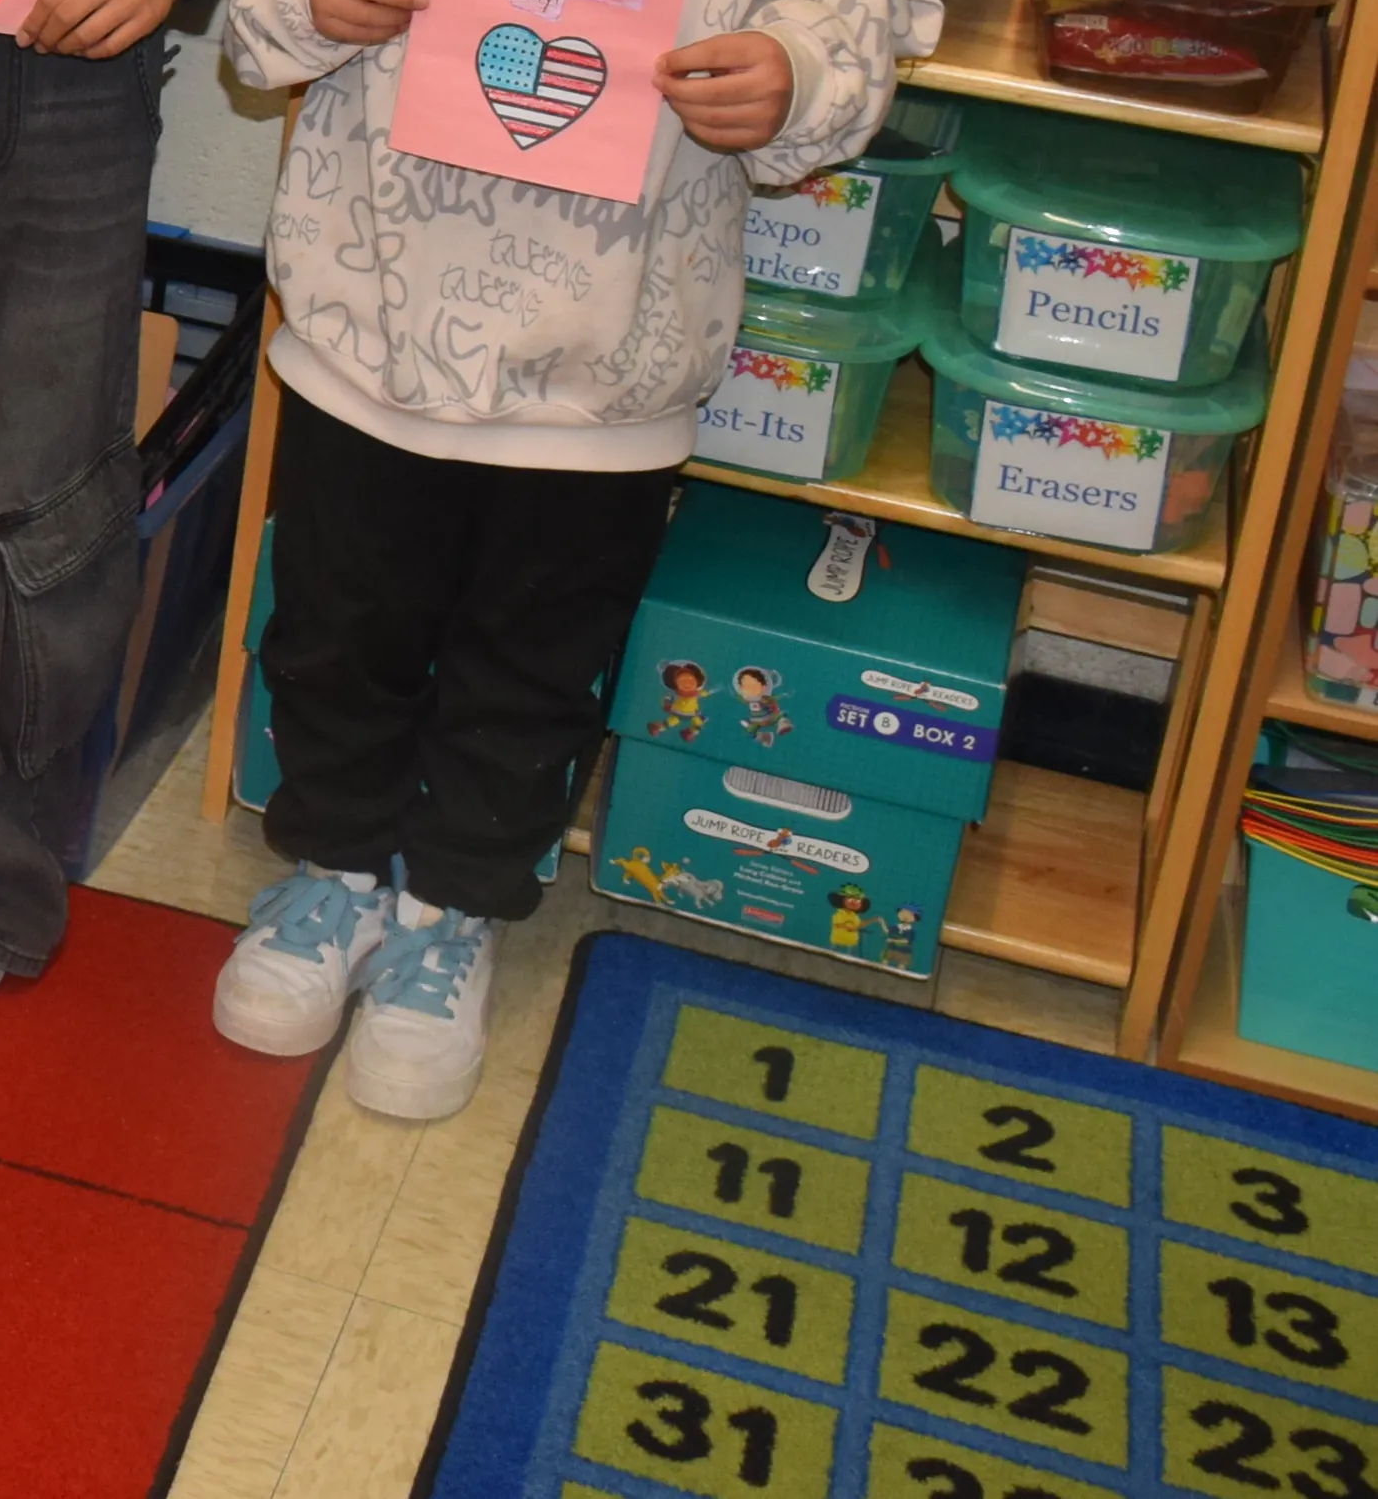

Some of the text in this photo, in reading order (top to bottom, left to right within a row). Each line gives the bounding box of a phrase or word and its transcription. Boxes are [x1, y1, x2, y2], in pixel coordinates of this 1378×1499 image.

[743, 207, 822, 249] Expo
[489, 229, 594, 302] QUEENS
[1025, 288, 1162, 338] Pencils
[996, 462, 1139, 514] Erasers
[836, 708, 976, 750] SET BOX 2
[691, 814, 862, 868] JUMP ROPE READERS
[751, 1045, 1310, 1237] 1 2 3
[705, 1141, 1351, 1371] 11 12 13
[654, 1250, 1377, 1499] 21 22 23
[626, 1380, 780, 1489] 31
